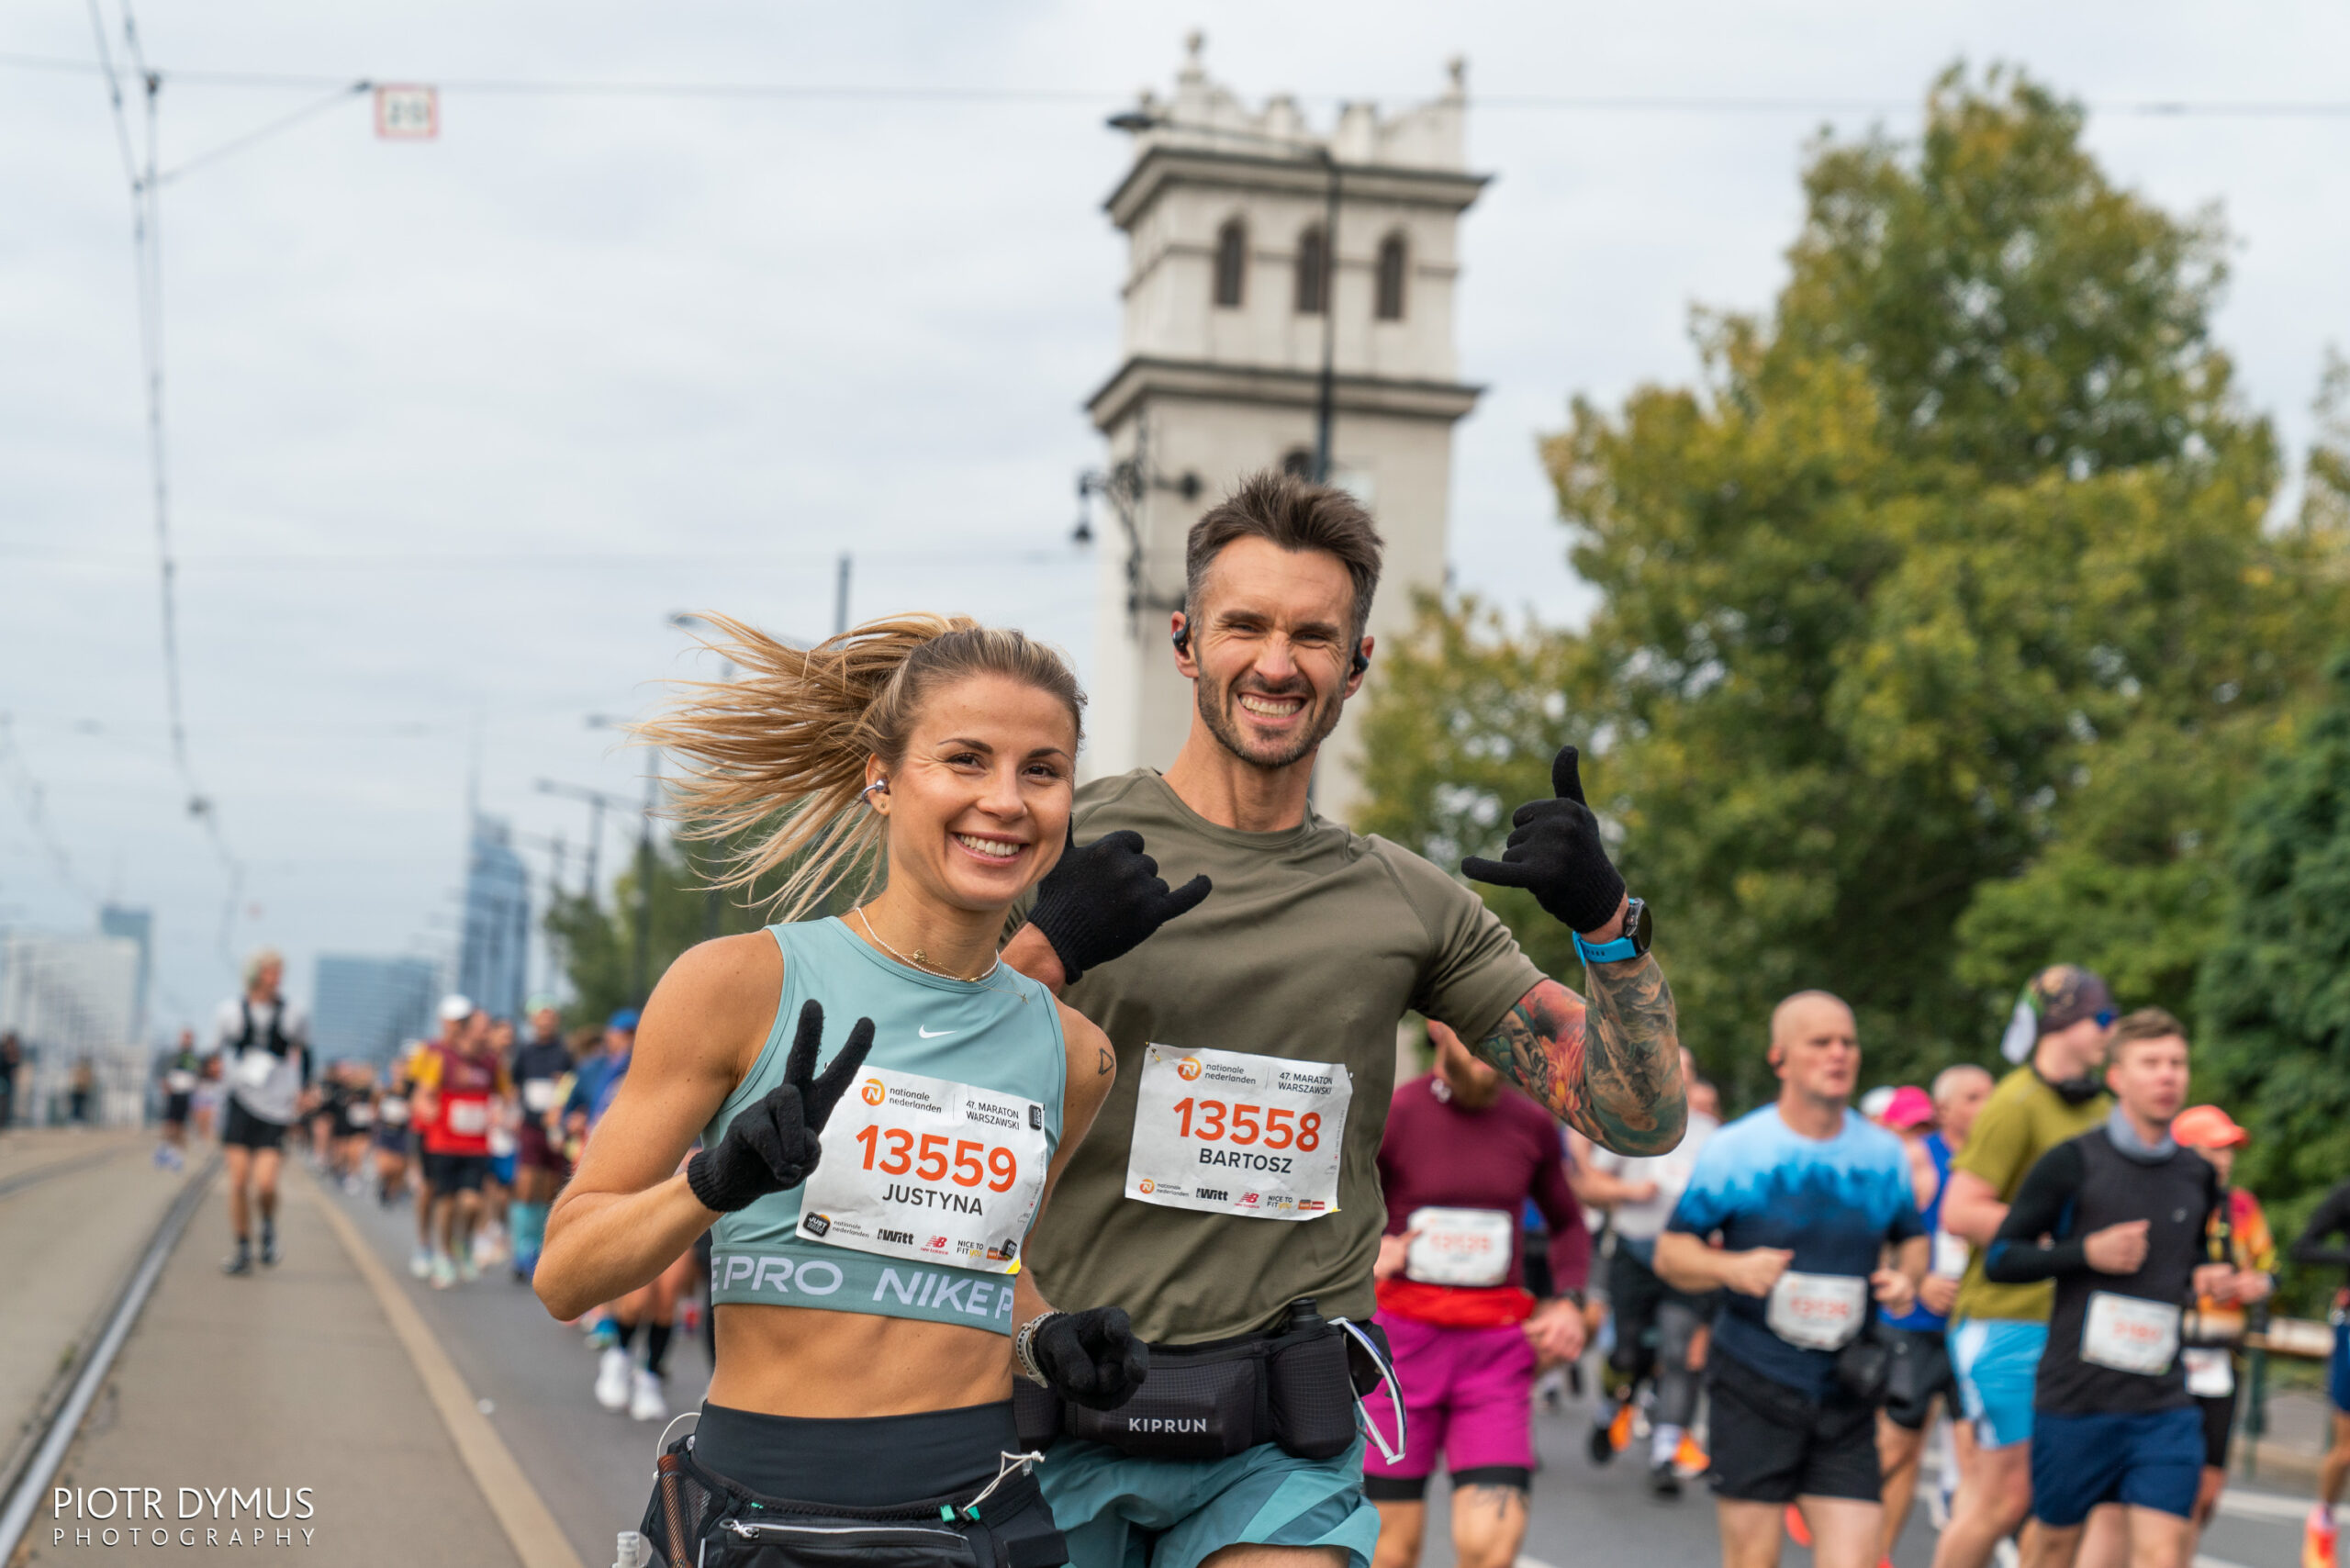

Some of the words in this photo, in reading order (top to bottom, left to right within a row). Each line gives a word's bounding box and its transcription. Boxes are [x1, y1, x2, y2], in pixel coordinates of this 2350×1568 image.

[1206, 1062, 1245, 1074] nationale
[1205, 1071, 1257, 1085] nederlanden
[1280, 1072, 1292, 1081] 47.
[1292, 1073, 1333, 1085] MARATON
[889, 1087, 931, 1102] nationale
[1278, 1081, 1331, 1094] WARSZAWSKI
[889, 1097, 942, 1114] nederlanden
[966, 1100, 977, 1111] 47.
[978, 1103, 1020, 1119] MARATON
[966, 1110, 1020, 1130] WARSZAWSKI
[1173, 1097, 1322, 1153] 13558
[856, 1125, 1017, 1193] 13559
[1199, 1148, 1292, 1173] BARTOSZ
[882, 1183, 983, 1215] JUSTYNA
[809, 1215, 828, 1228] JUST
[834, 1219, 862, 1229] nationale
[832, 1226, 869, 1238] nederlanden
[957, 1239, 975, 1249] NICE
[976, 1242, 984, 1250] TO
[957, 1247, 969, 1255] FIT
[968, 1249, 983, 1259] you
[723, 1255, 844, 1295] PRO
[873, 1268, 994, 1316] NIKE
[994, 1286, 1014, 1323] P
[1129, 1417, 1206, 1433] KIPRUN
